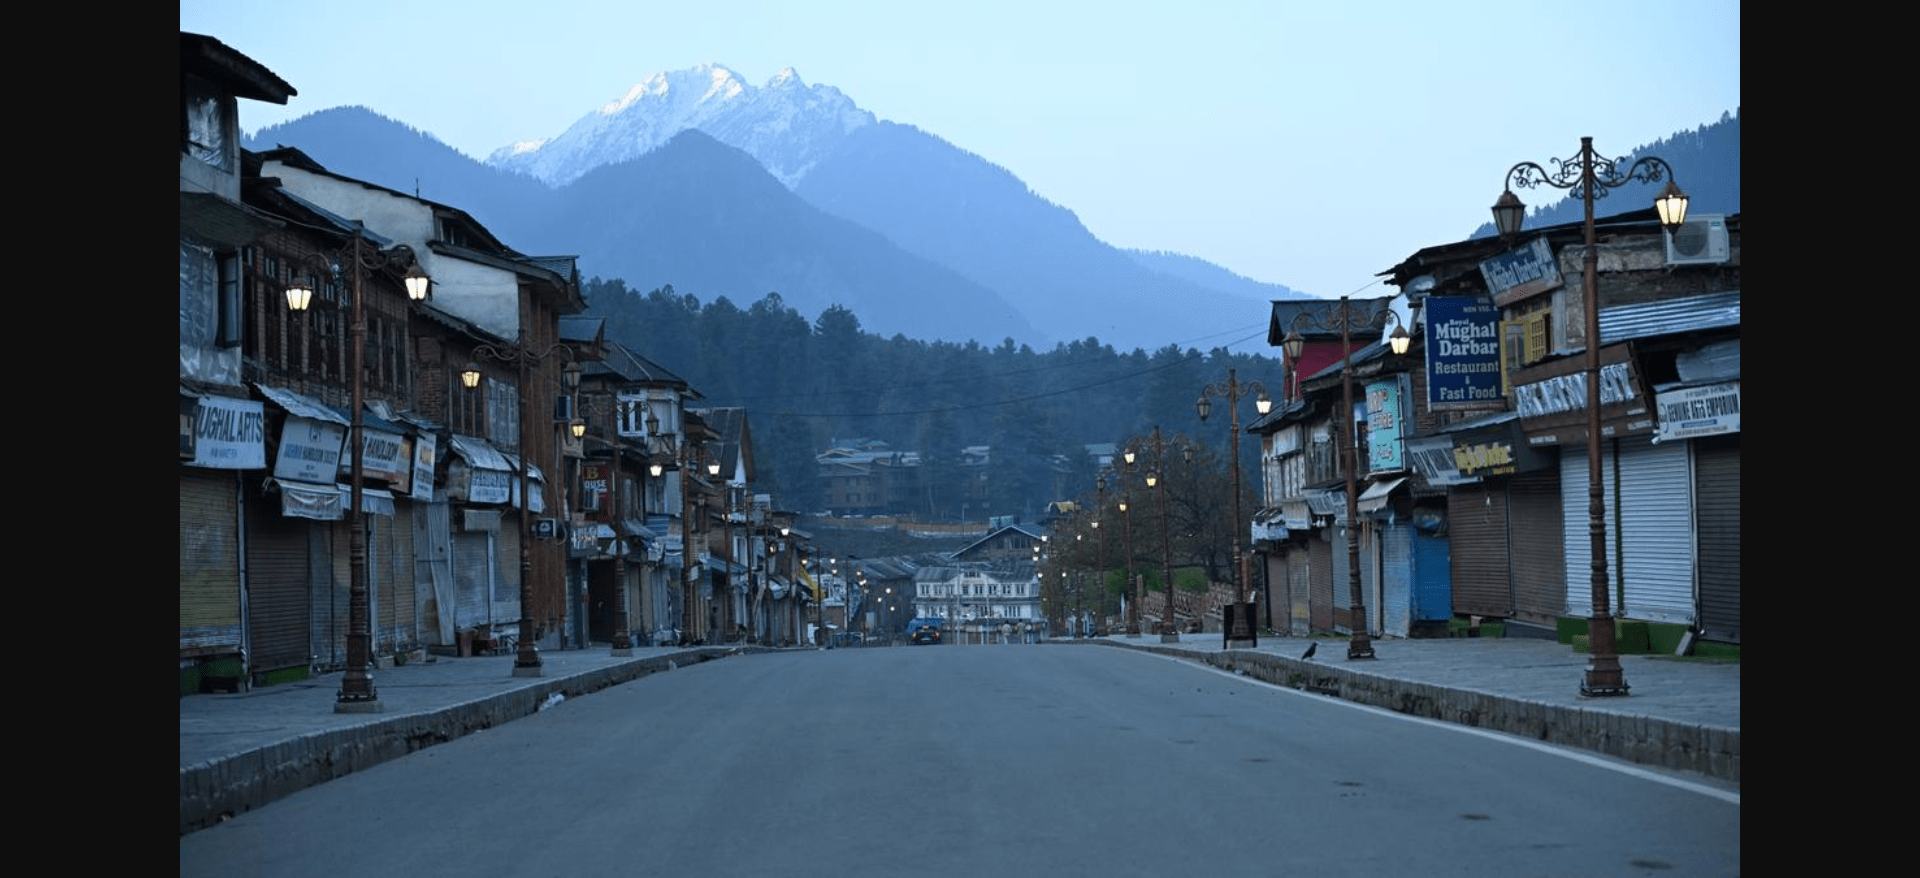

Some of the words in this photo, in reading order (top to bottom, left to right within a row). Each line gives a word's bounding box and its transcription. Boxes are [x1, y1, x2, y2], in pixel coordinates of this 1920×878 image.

[1434, 321, 1497, 343] Mughal
[1439, 339, 1498, 356] Darbar
[1434, 360, 1499, 375] Restaurant
[1440, 387, 1465, 400] Fast
[1468, 385, 1497, 399] Food
[1705, 393, 1740, 418] EMPORIUM
[198, 405, 236, 442] UGHAL
[236, 411, 263, 443] ARTS
[583, 479, 607, 489] OUSE
